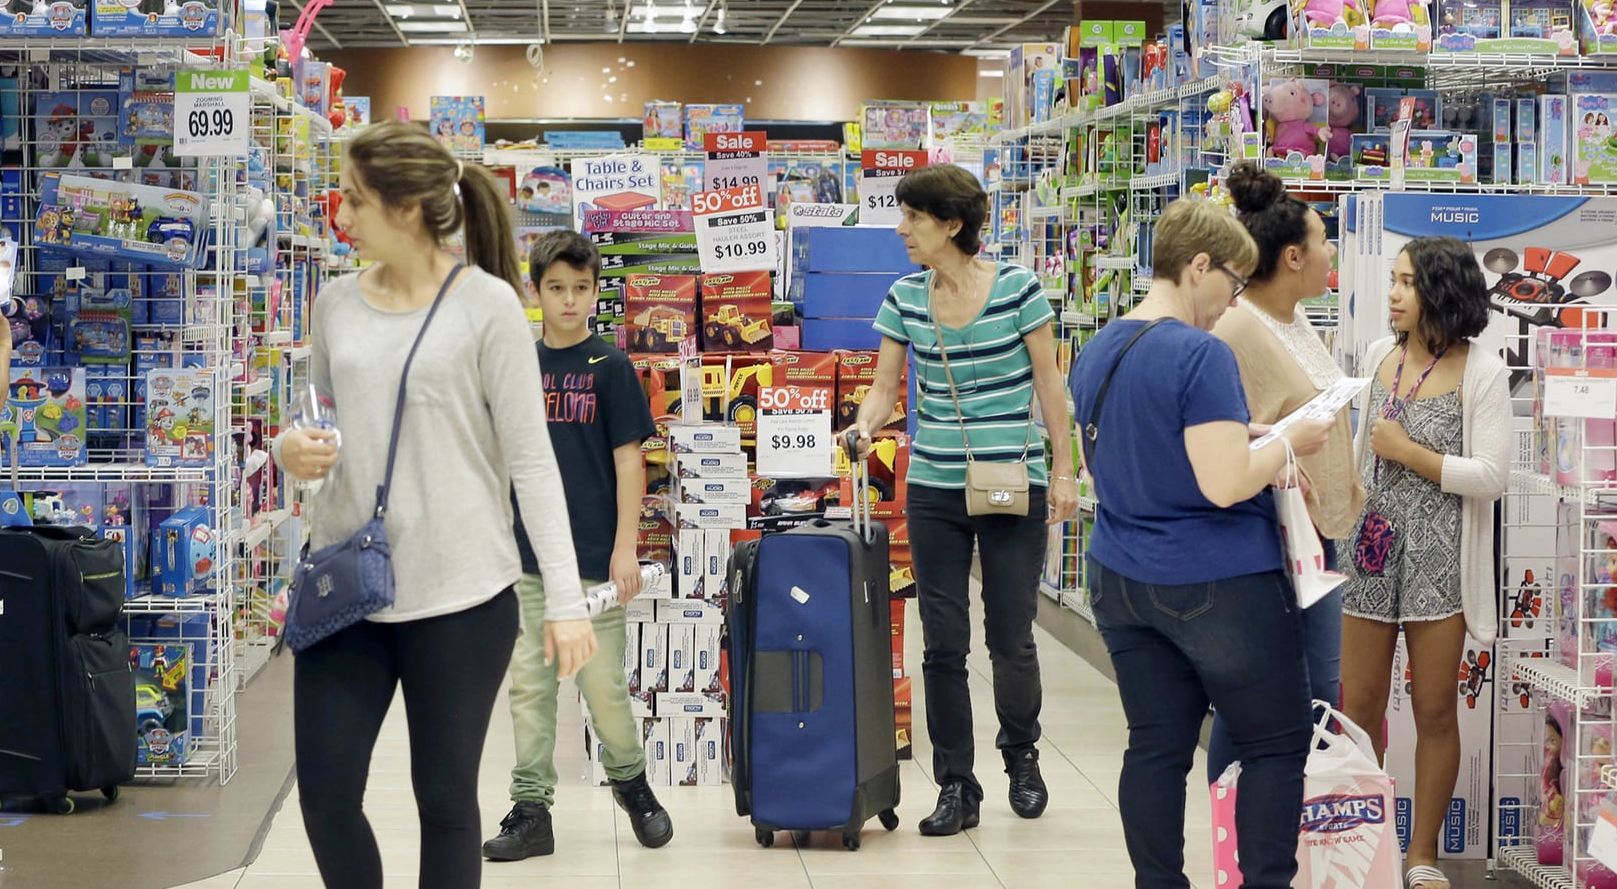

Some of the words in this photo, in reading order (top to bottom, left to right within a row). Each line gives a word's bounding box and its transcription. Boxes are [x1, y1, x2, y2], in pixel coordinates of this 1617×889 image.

[191, 73, 234, 89] New
[189, 109, 233, 137] 69.99
[716, 134, 753, 149] Sale
[585, 161, 627, 175] Table
[631, 160, 642, 172] &
[875, 152, 914, 167] Sale
[876, 169, 895, 177] Save
[576, 178, 624, 191] Chairs
[628, 175, 654, 188] Set
[713, 175, 759, 190] $1499
[693, 190, 731, 213] 50%
[732, 187, 758, 207] off
[717, 217, 737, 225] Save
[739, 214, 757, 223] 50%
[1431, 213, 1480, 223] MUSIC
[740, 232, 765, 240] ASSORT
[715, 241, 766, 259] $10.99
[563, 373, 595, 390] CLUB
[1574, 385, 1589, 394] 7.48
[760, 388, 800, 408] 50%
[800, 389, 828, 408] off
[545, 391, 596, 424] ELONA
[771, 434, 816, 450] $9.98
[1451, 800, 1461, 850] MUSIC
